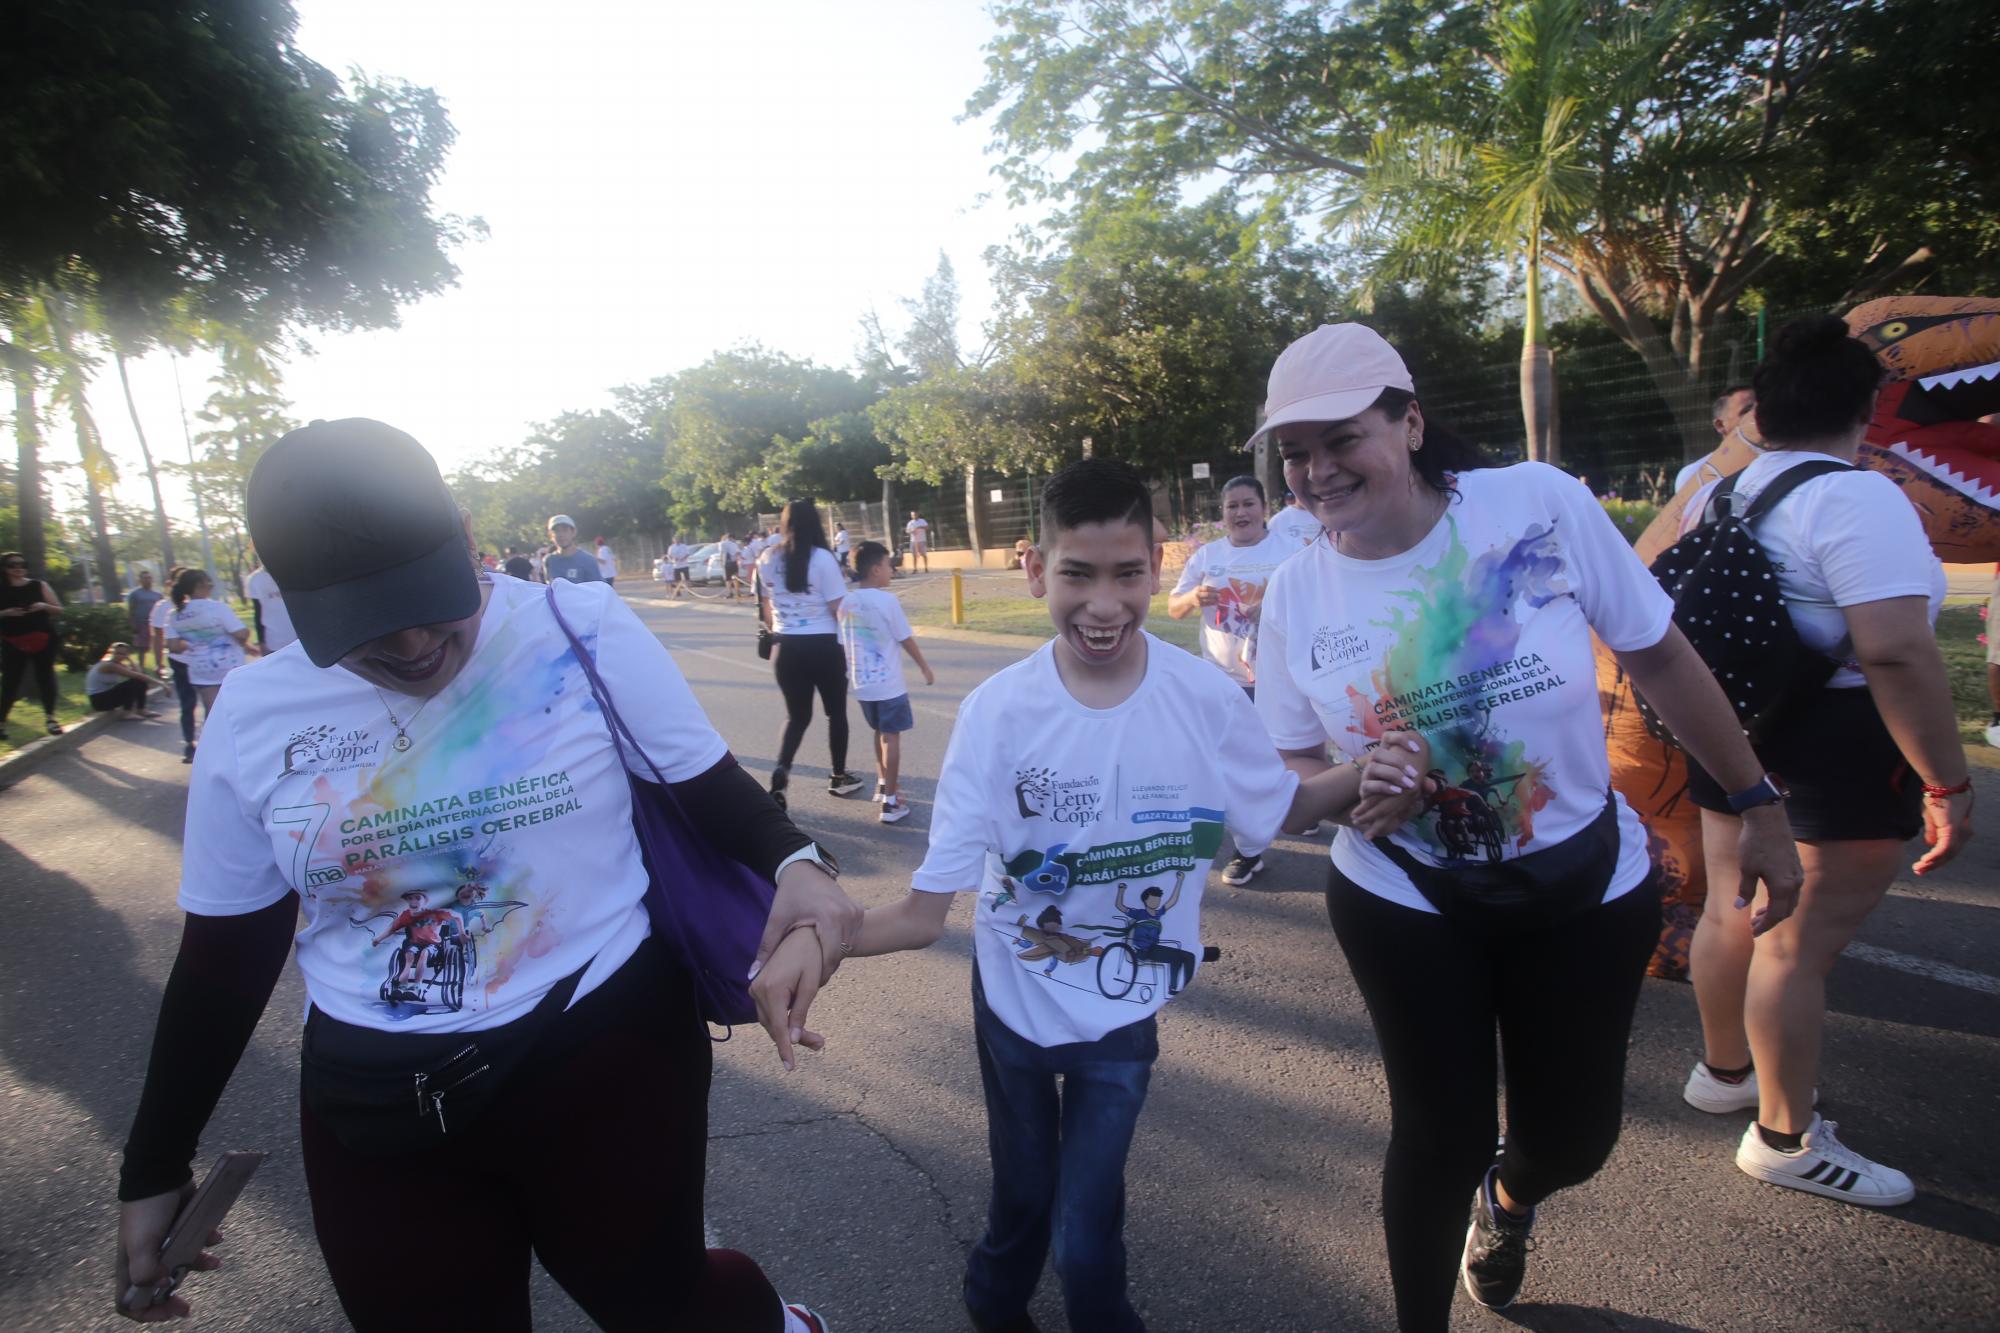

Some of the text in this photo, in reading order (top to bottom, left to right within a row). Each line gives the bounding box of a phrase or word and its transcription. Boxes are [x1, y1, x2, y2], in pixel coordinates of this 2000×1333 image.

[1330, 639, 1370, 661] Coppel
[1374, 652, 1544, 715] CAMINATA BENÉFICA
[1378, 664, 1552, 726] POR EL DÍA INTERNACIONAL DE LA
[1385, 703, 1472, 732] ARÁLISIS
[1475, 673, 1567, 712] CEREBRAL
[340, 770, 570, 834] CAMINATA BENÉFICA
[1051, 776, 1100, 790] Fundación
[1052, 790, 1098, 809] Letty
[341, 784, 574, 849] POR EL DÍA INTERNACIONAL DE LA
[345, 825, 475, 868] PARÁLISIS
[481, 797, 583, 835] CEREBRAL
[308, 868, 344, 885] ma
[1076, 844, 1143, 868] CAMINATA
